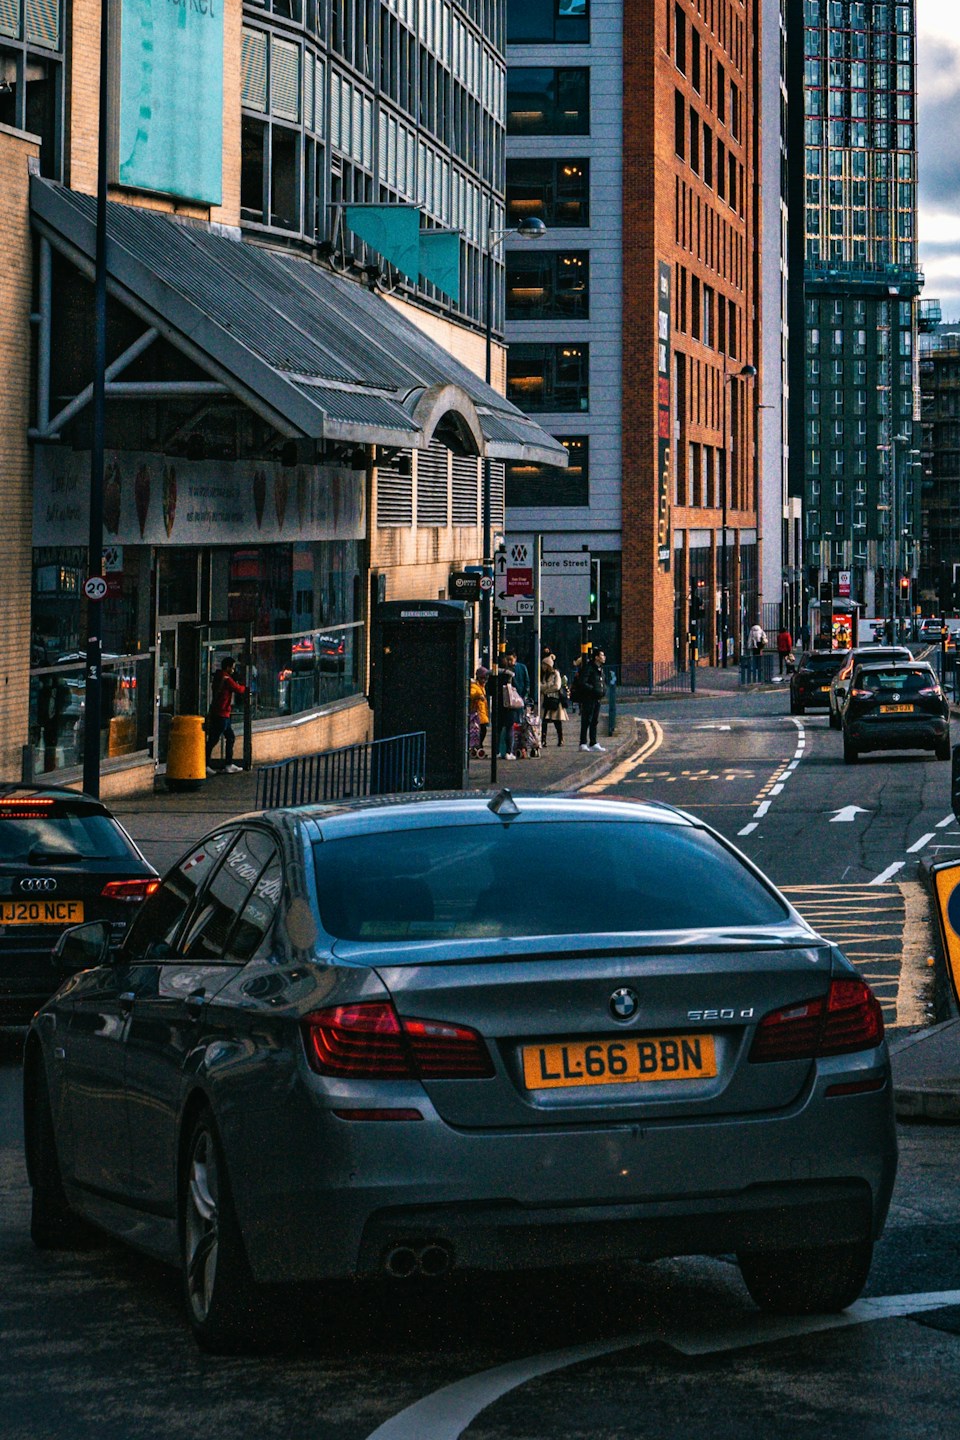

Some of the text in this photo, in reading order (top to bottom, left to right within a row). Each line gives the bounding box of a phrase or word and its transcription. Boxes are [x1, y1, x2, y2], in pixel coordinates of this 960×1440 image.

[87, 582, 106, 594] 20
[44, 903, 78, 920] NCF
[539, 1038, 702, 1080] LL66 BBN
